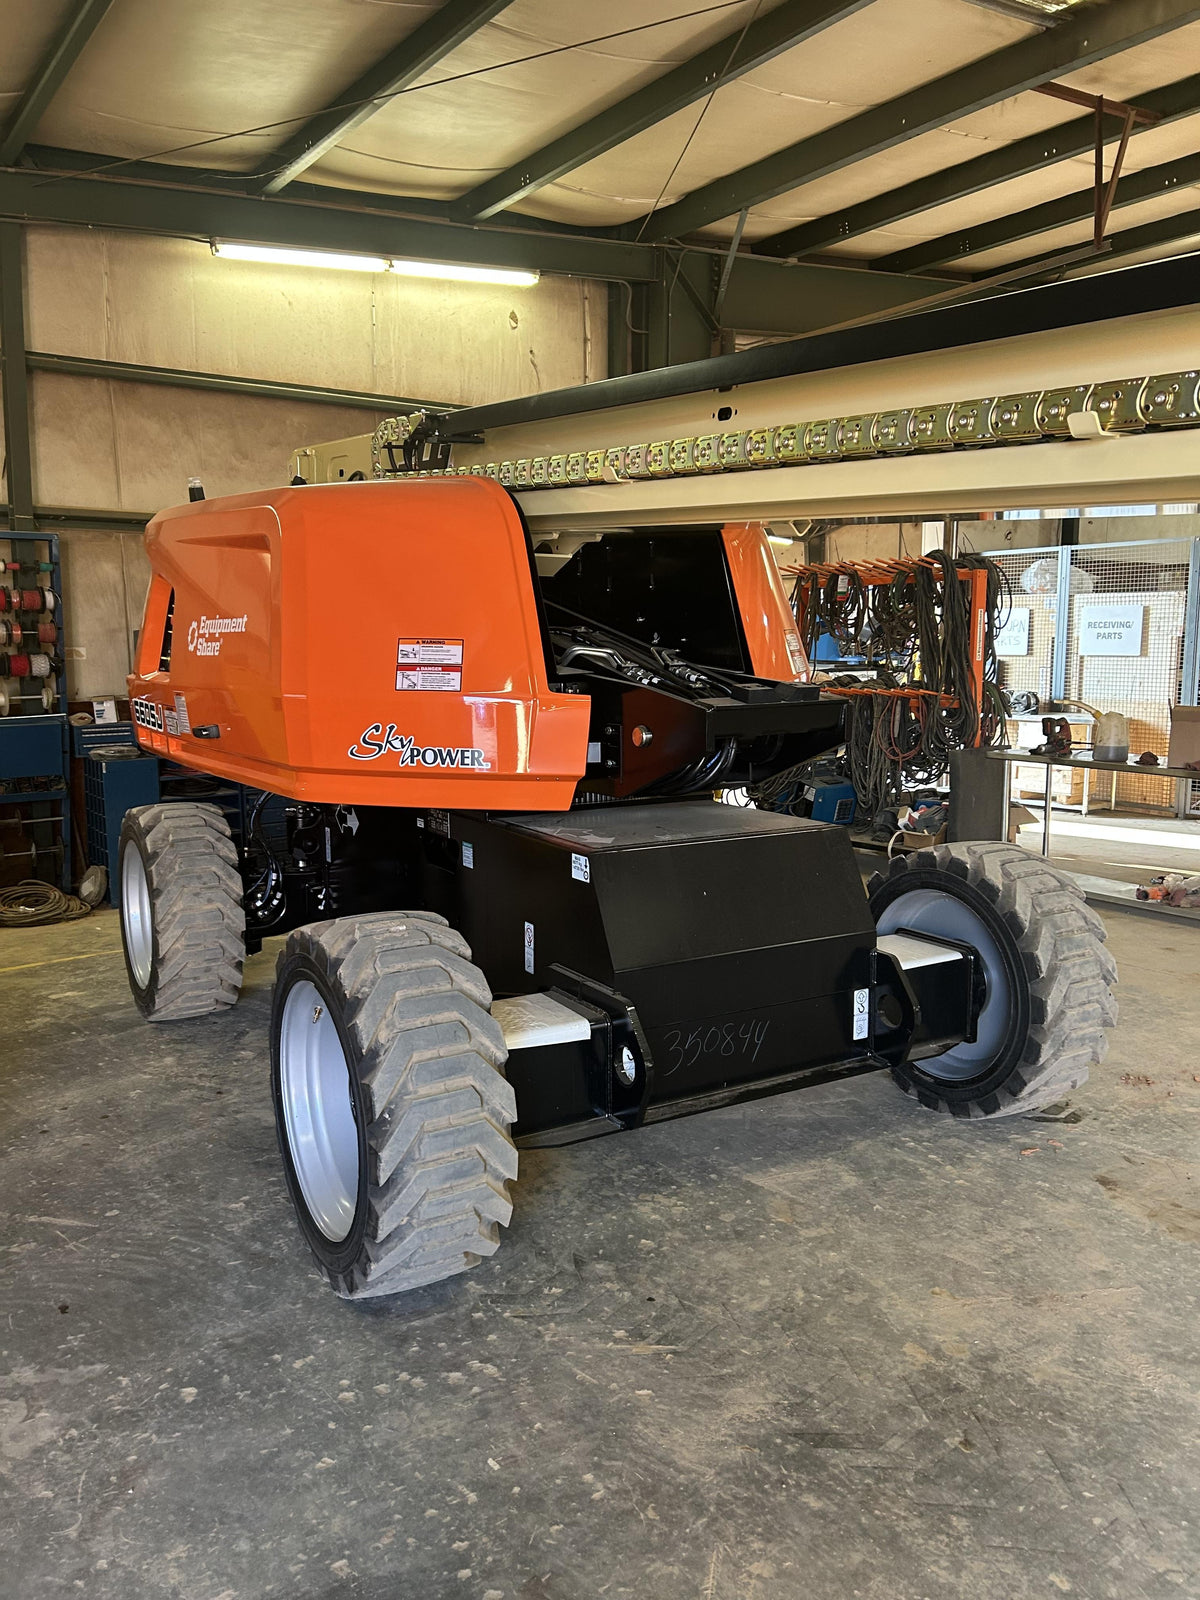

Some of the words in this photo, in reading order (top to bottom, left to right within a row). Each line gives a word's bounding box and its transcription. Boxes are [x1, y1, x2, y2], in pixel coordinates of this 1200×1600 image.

[199, 614, 248, 637] Equipment
[1087, 620, 1135, 629] RECEIVING/
[1096, 632, 1123, 640] PARTS
[196, 638, 221, 656] Share
[348, 723, 414, 766] Sky
[408, 747, 485, 767] POWER
[664, 1020, 769, 1077] 350844
